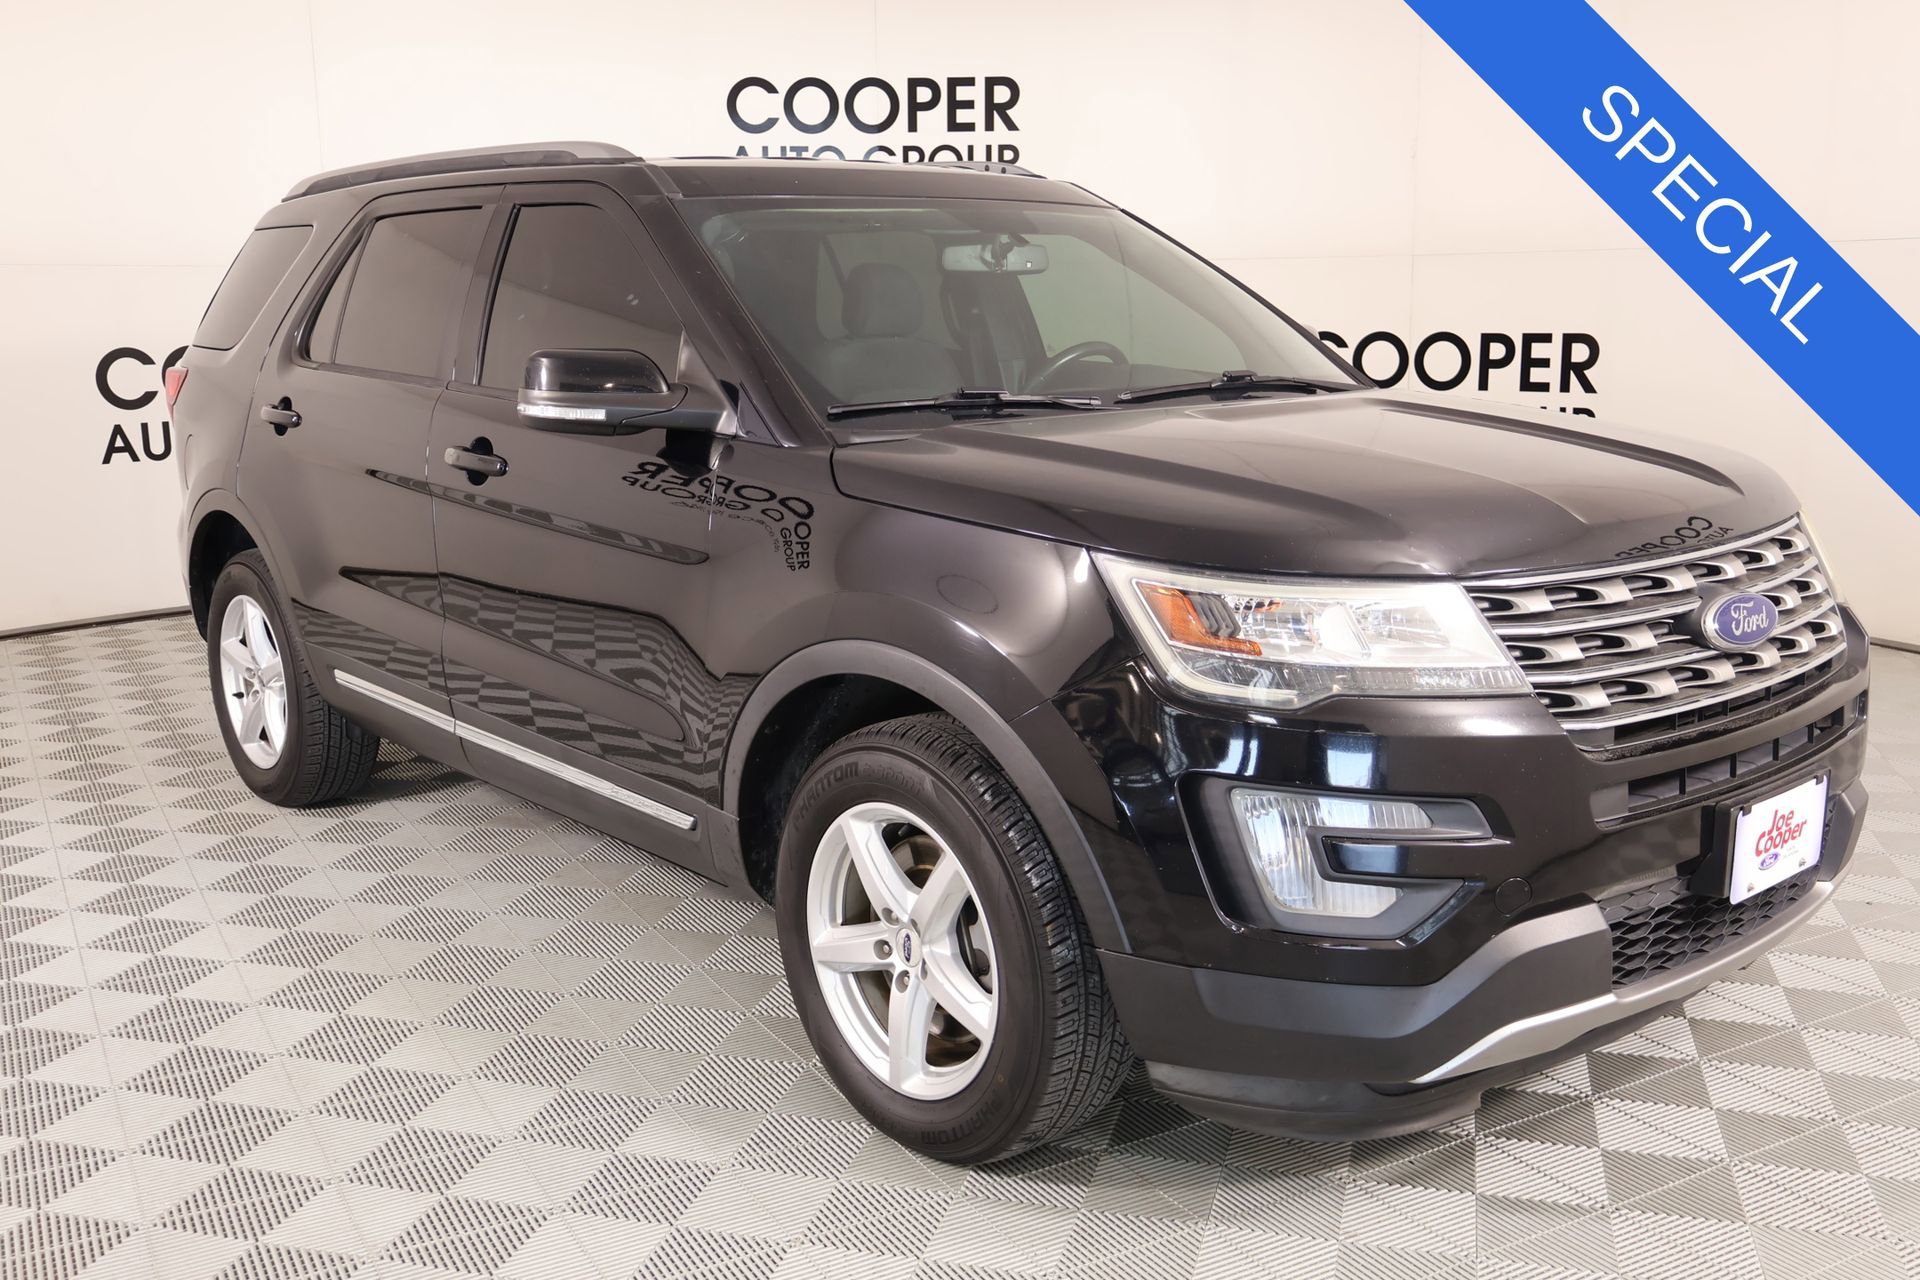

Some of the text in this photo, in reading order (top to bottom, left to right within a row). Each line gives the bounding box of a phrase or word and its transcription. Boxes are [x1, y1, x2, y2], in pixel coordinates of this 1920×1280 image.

[726, 76, 1021, 134] COOPER
[101, 421, 172, 465] AU
[1729, 600, 1770, 637] Ford
[1754, 818, 1808, 858] Cooper
[1766, 808, 1795, 837] Joe
